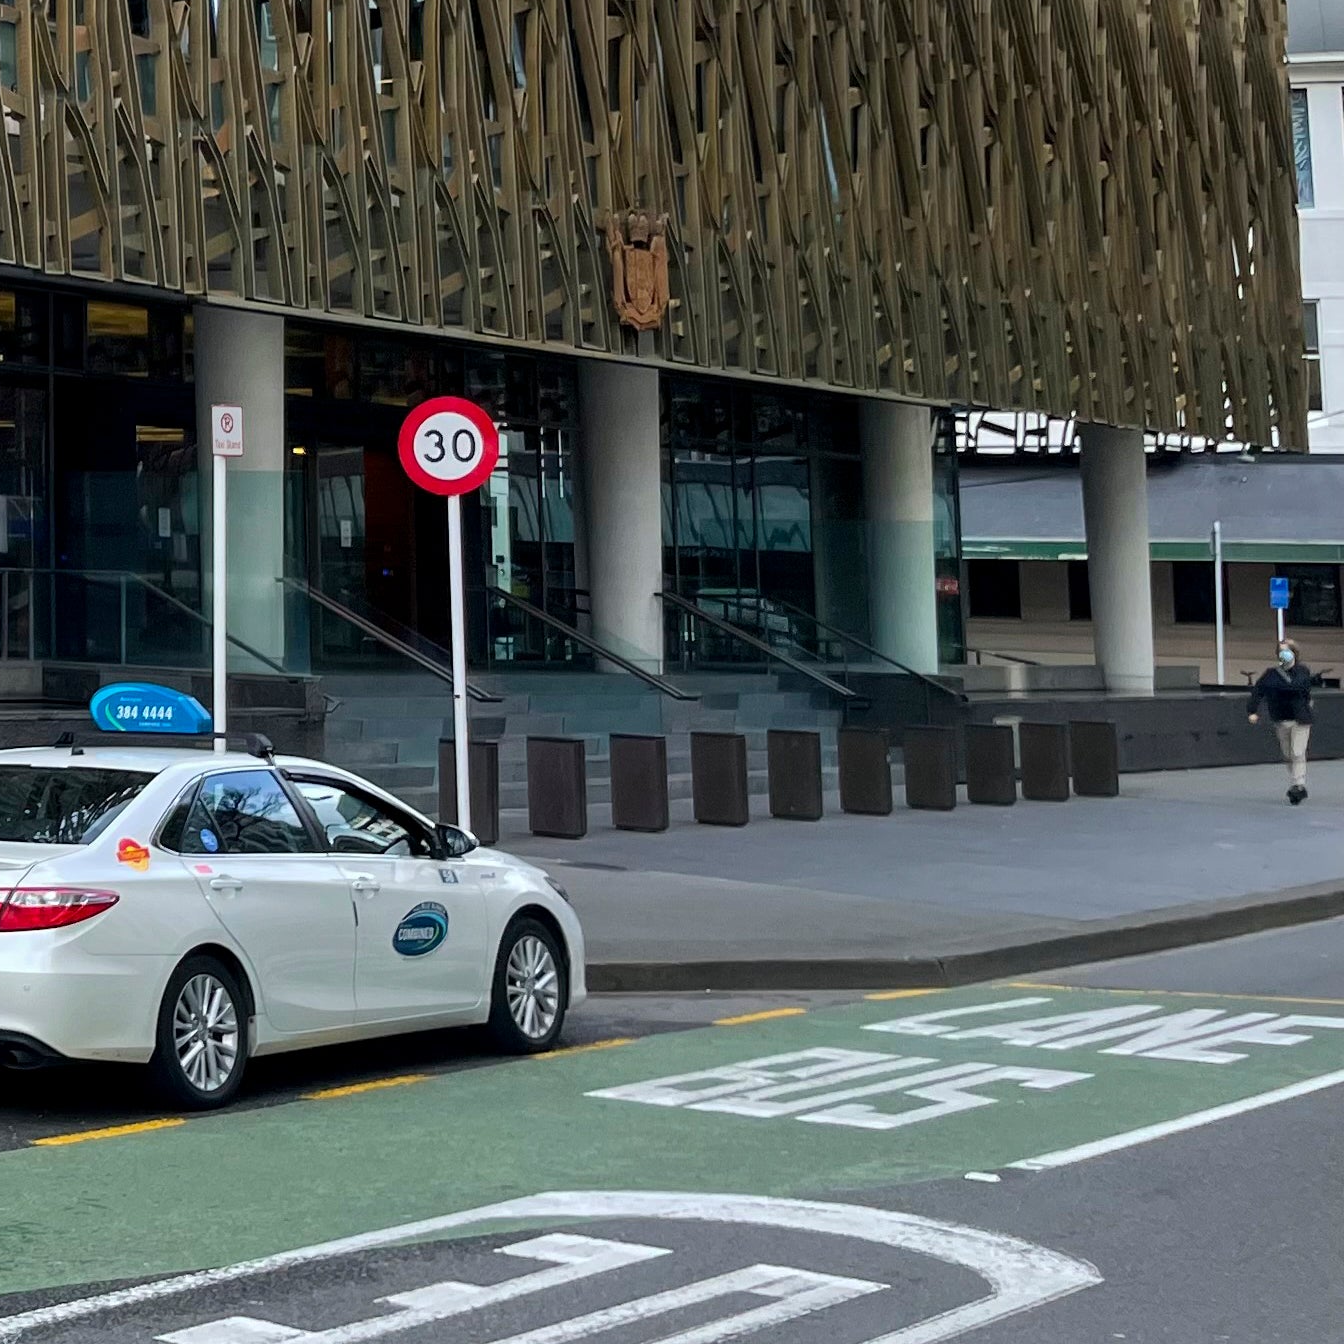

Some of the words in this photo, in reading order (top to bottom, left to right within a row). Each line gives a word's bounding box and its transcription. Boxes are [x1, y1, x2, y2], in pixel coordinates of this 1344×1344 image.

[424, 429, 476, 463] 30
[116, 705, 138, 719] 384
[142, 705, 172, 720] 4444
[860, 997, 1344, 1064] LANE
[584, 1047, 1095, 1129] BUS
